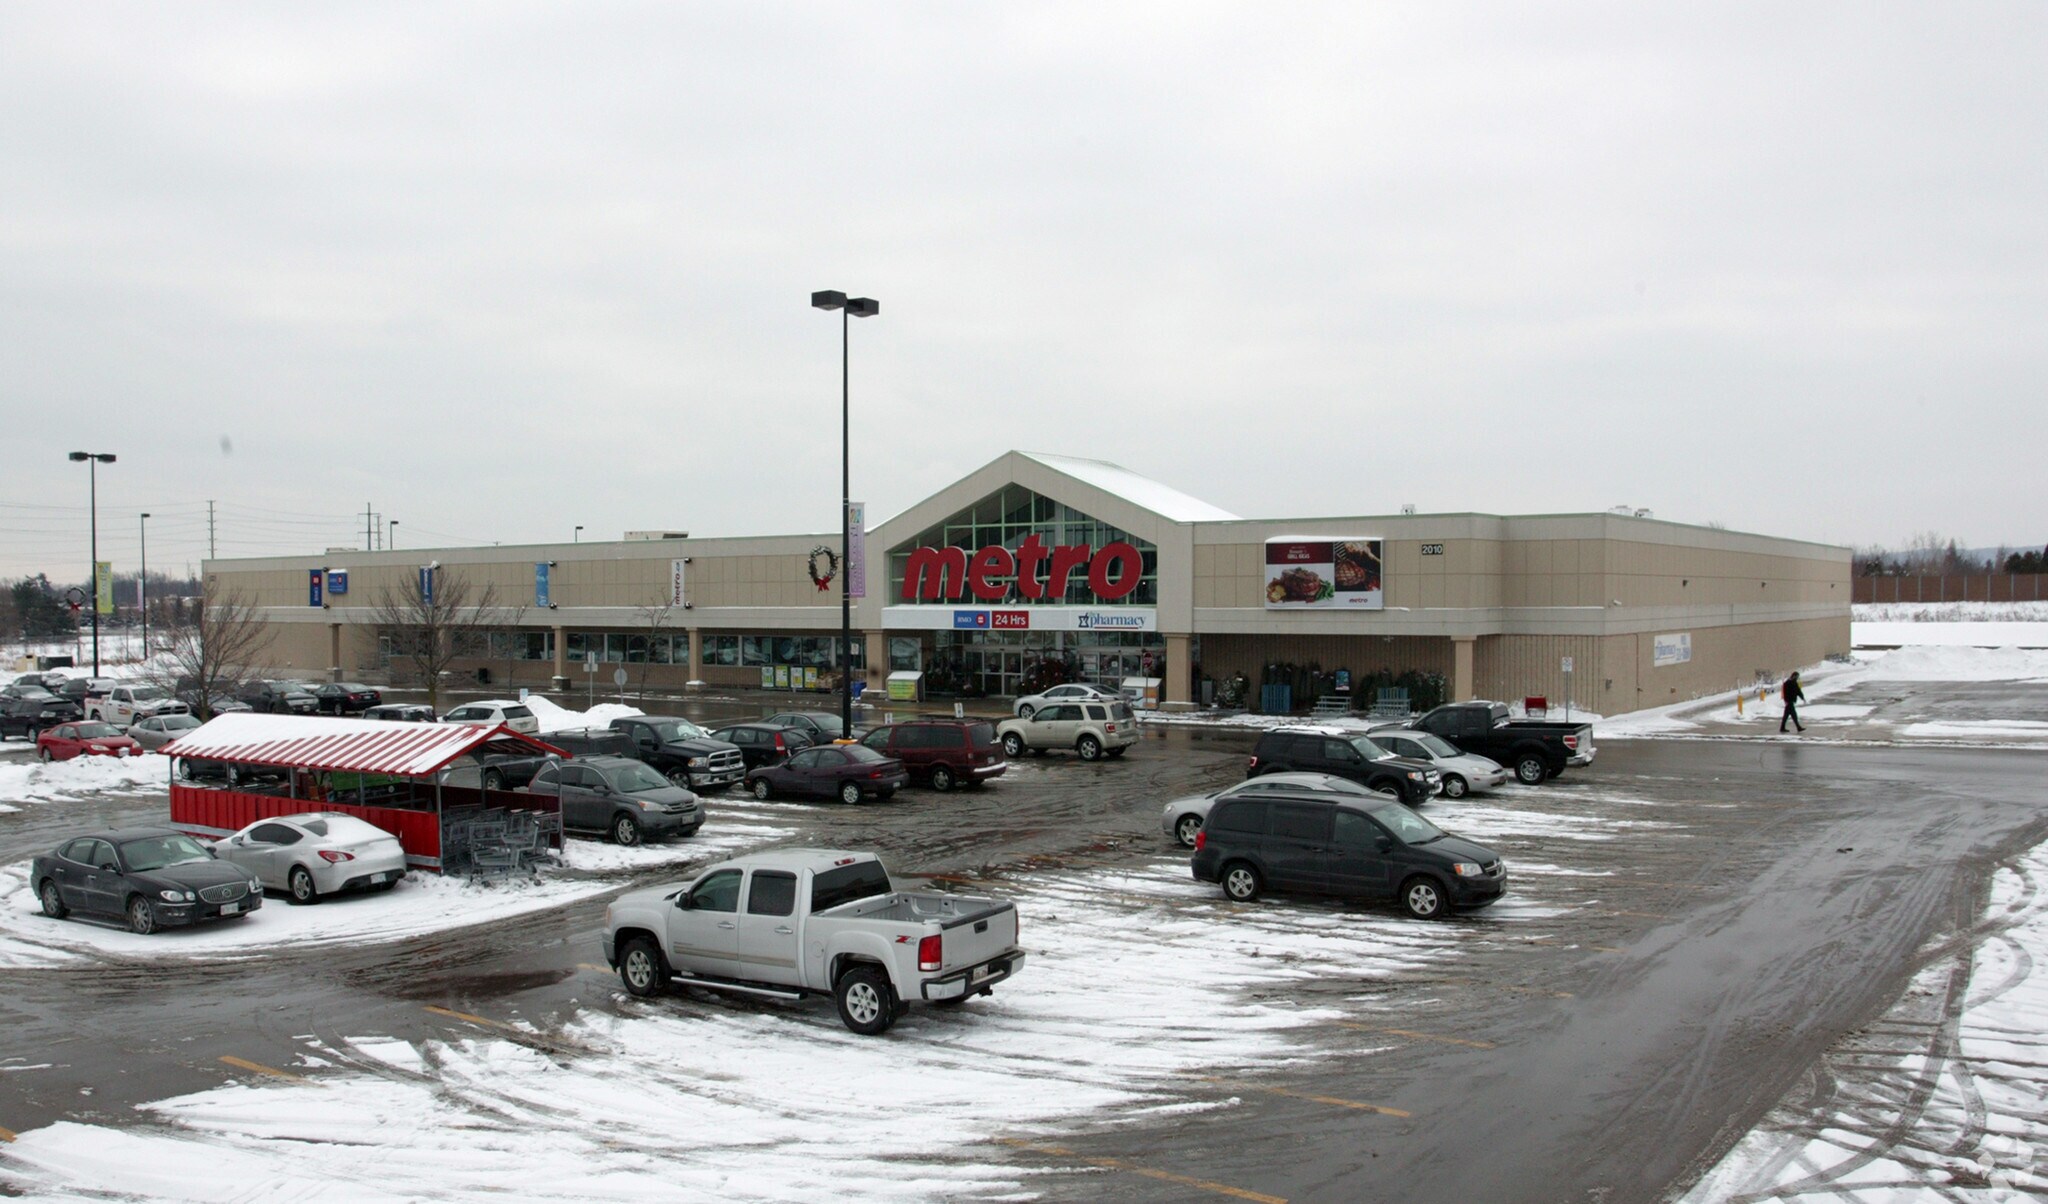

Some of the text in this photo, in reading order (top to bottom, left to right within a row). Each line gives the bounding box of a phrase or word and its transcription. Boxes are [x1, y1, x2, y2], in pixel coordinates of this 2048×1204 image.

[1421, 545, 1443, 555] 2010
[901, 533, 1143, 599] metro
[995, 615, 1026, 624] 24 Hrs
[1090, 613, 1147, 628] pharmacy
